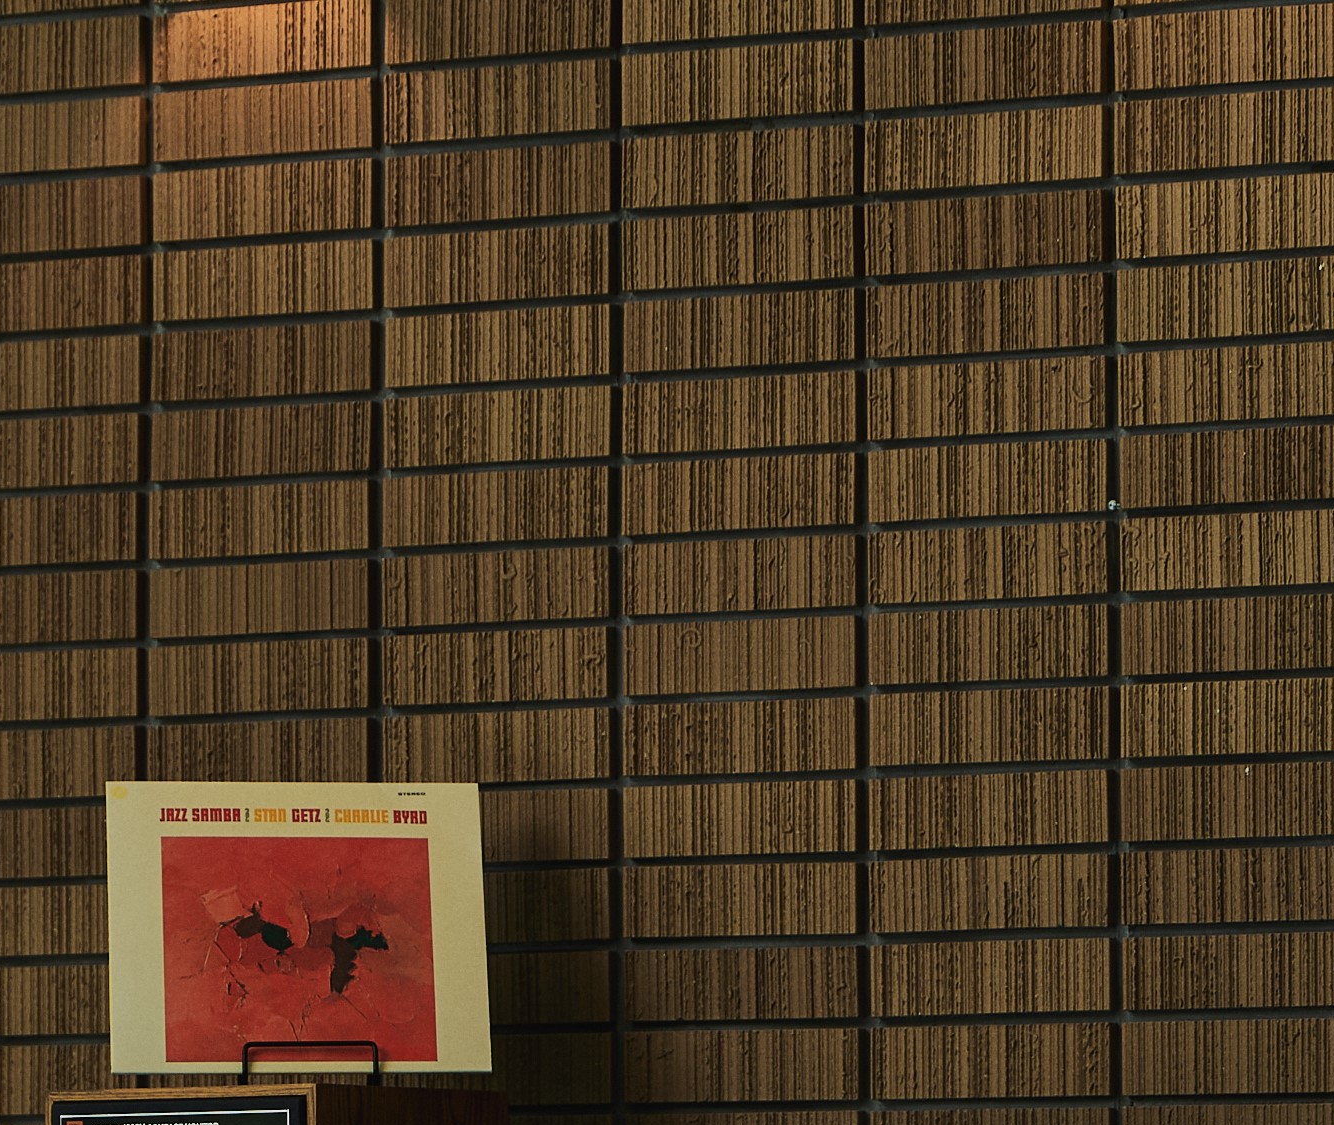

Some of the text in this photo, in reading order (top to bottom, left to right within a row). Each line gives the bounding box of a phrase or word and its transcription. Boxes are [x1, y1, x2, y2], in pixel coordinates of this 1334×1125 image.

[160, 808, 427, 824] JAZZ SAMBA STAN GETZ CHARLIE BYRD
